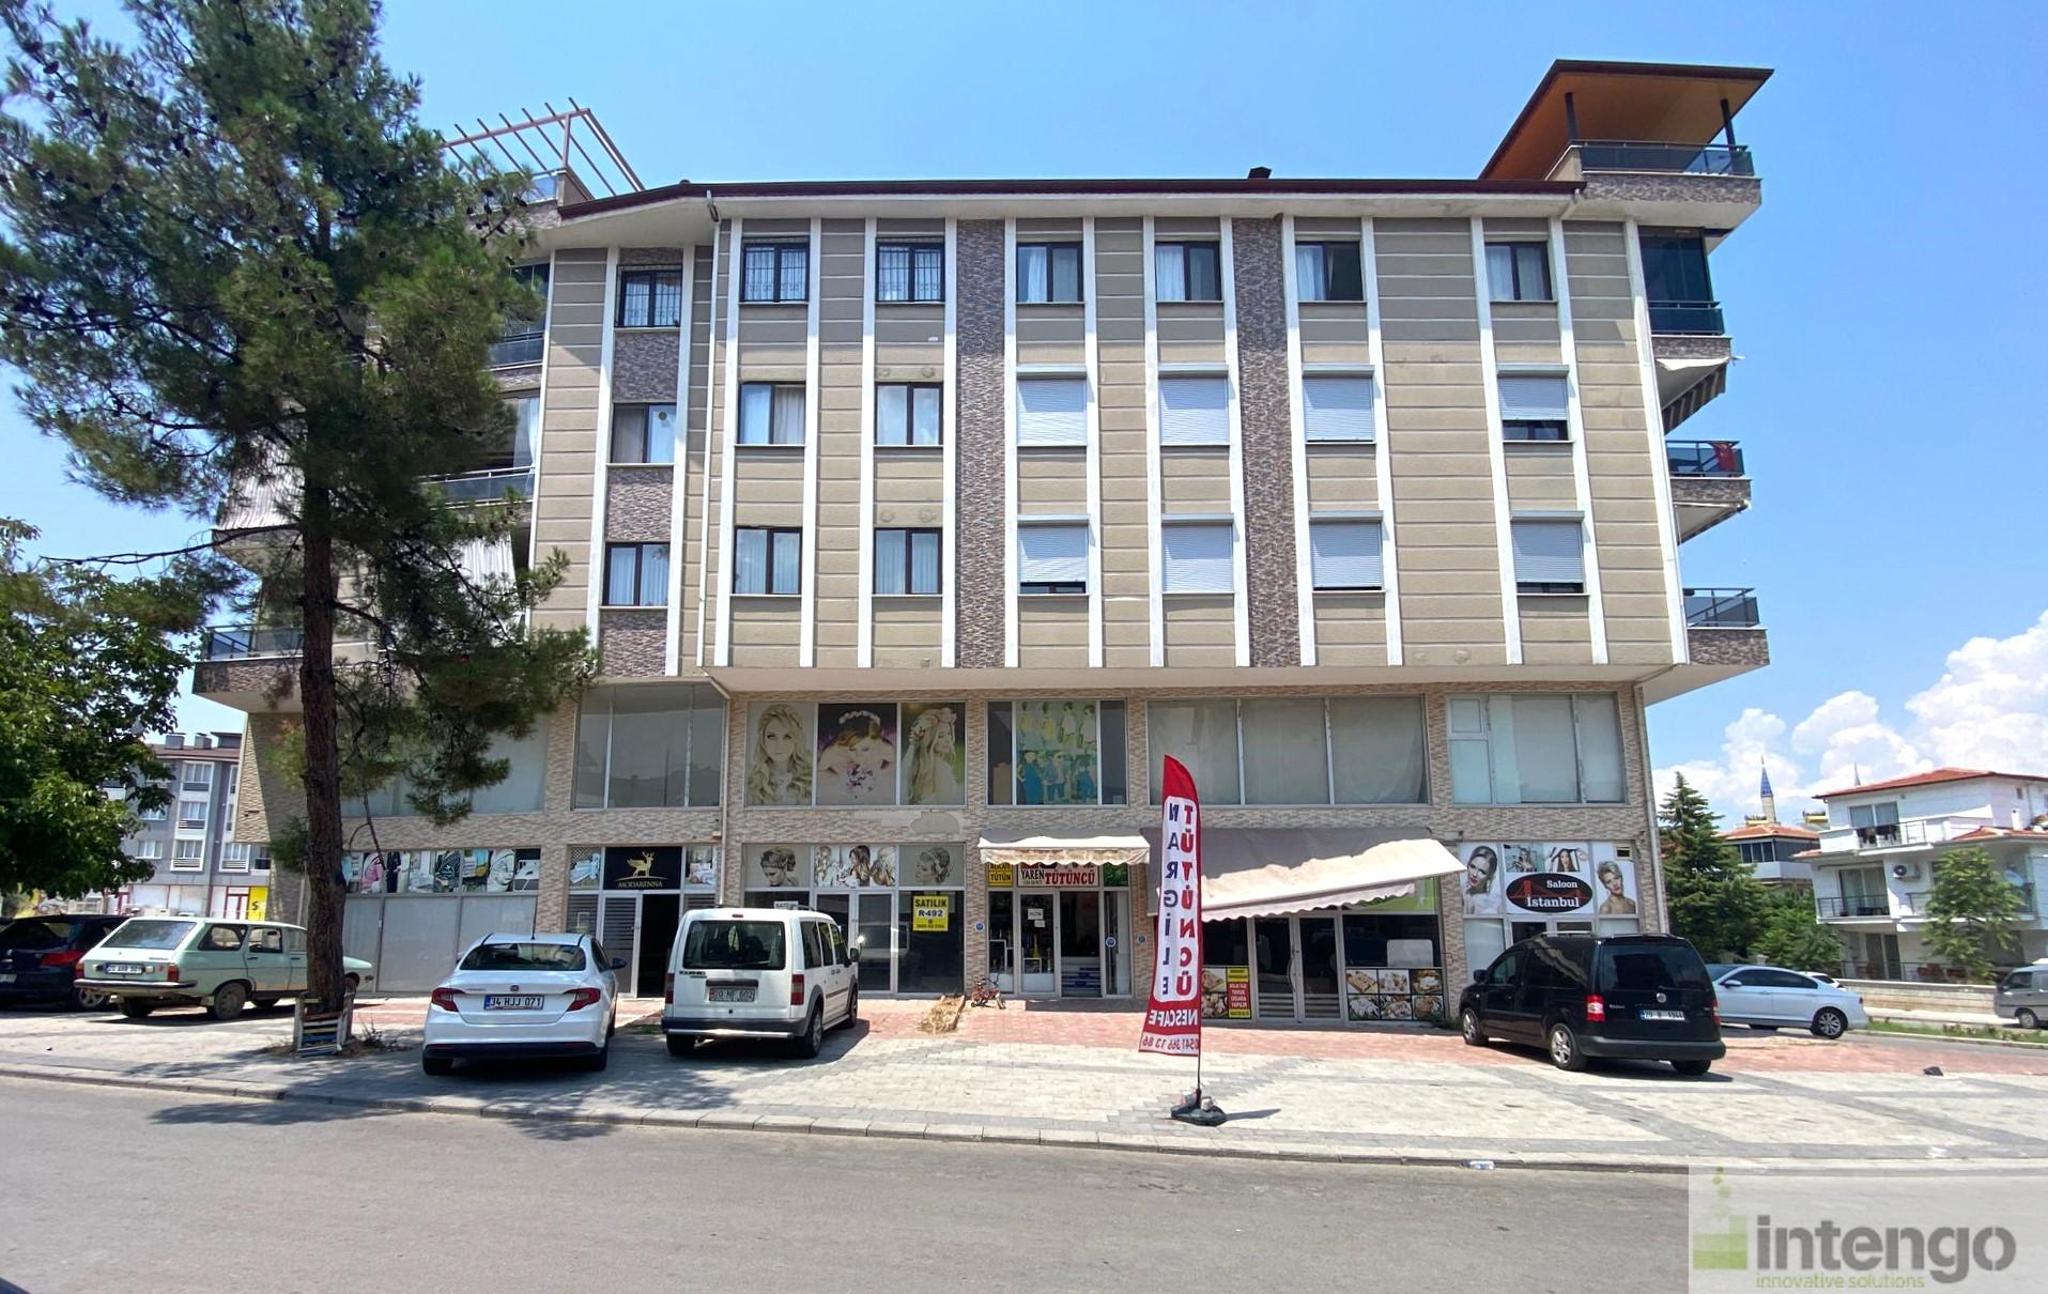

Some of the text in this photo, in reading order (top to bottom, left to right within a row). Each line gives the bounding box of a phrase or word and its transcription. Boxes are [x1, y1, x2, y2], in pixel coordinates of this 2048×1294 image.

[1045, 869, 1095, 884] TÜTÜNCÜ
[1546, 879, 1578, 888] Saloon
[915, 899, 947, 908] SATILIK
[491, 997, 501, 1006] 34
[504, 997, 521, 1006] HJJ
